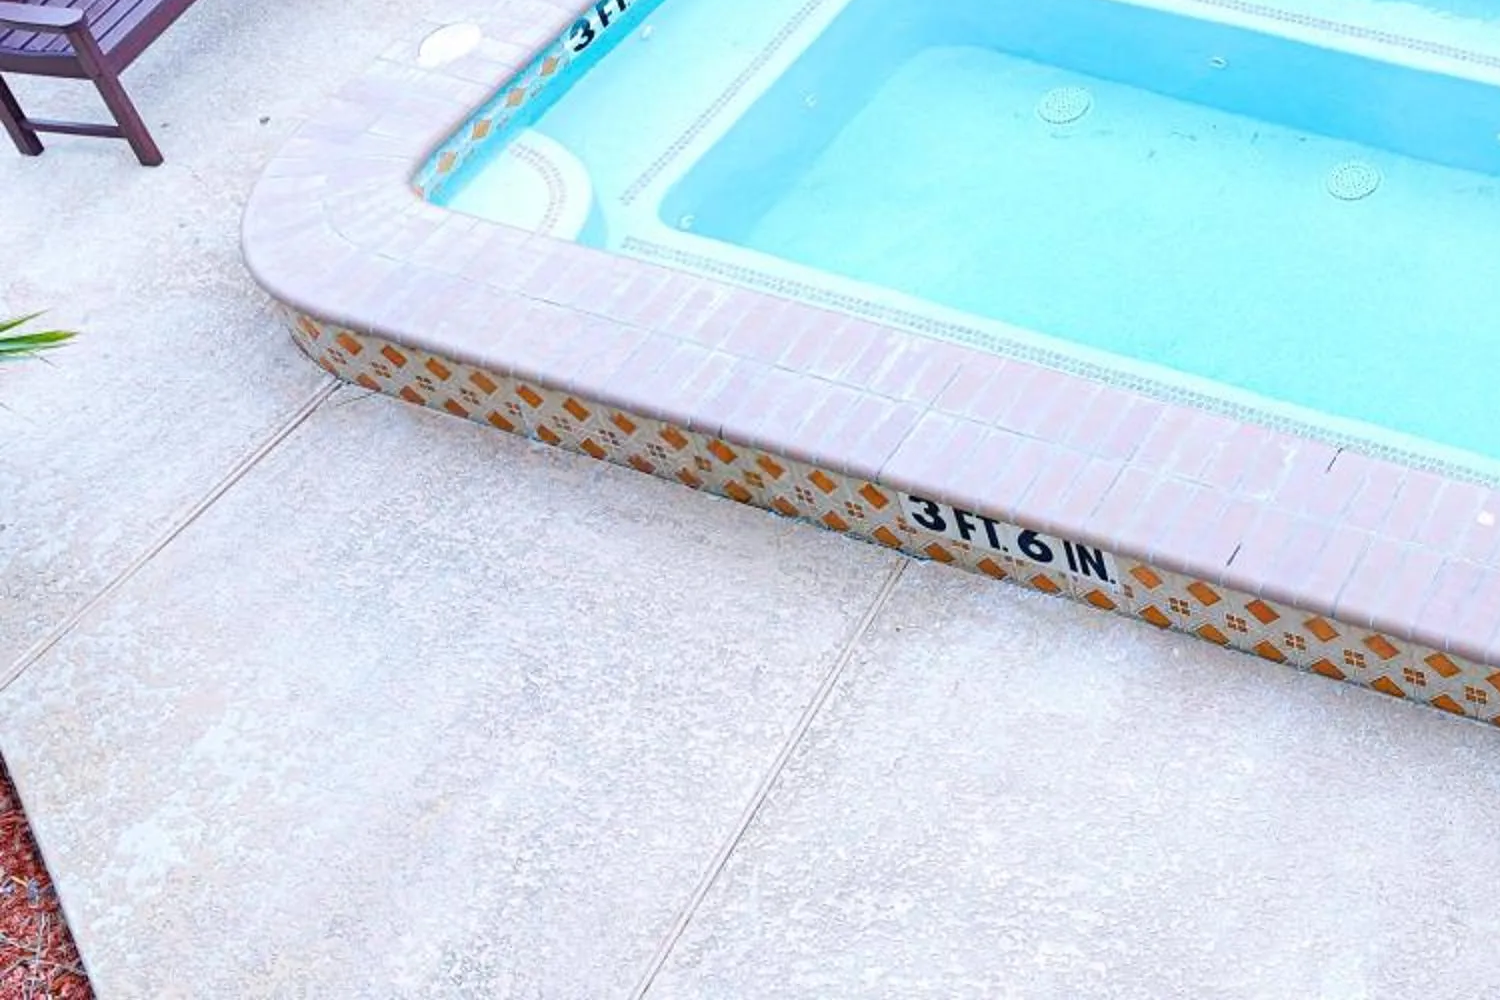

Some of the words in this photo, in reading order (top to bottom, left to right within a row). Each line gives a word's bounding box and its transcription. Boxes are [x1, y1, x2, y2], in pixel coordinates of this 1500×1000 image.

[569, 16, 595, 52] 3
[908, 495, 947, 532] 3
[952, 506, 1009, 552] FT.
[1018, 529, 1053, 563] 6
[1063, 539, 1116, 584] IN.
